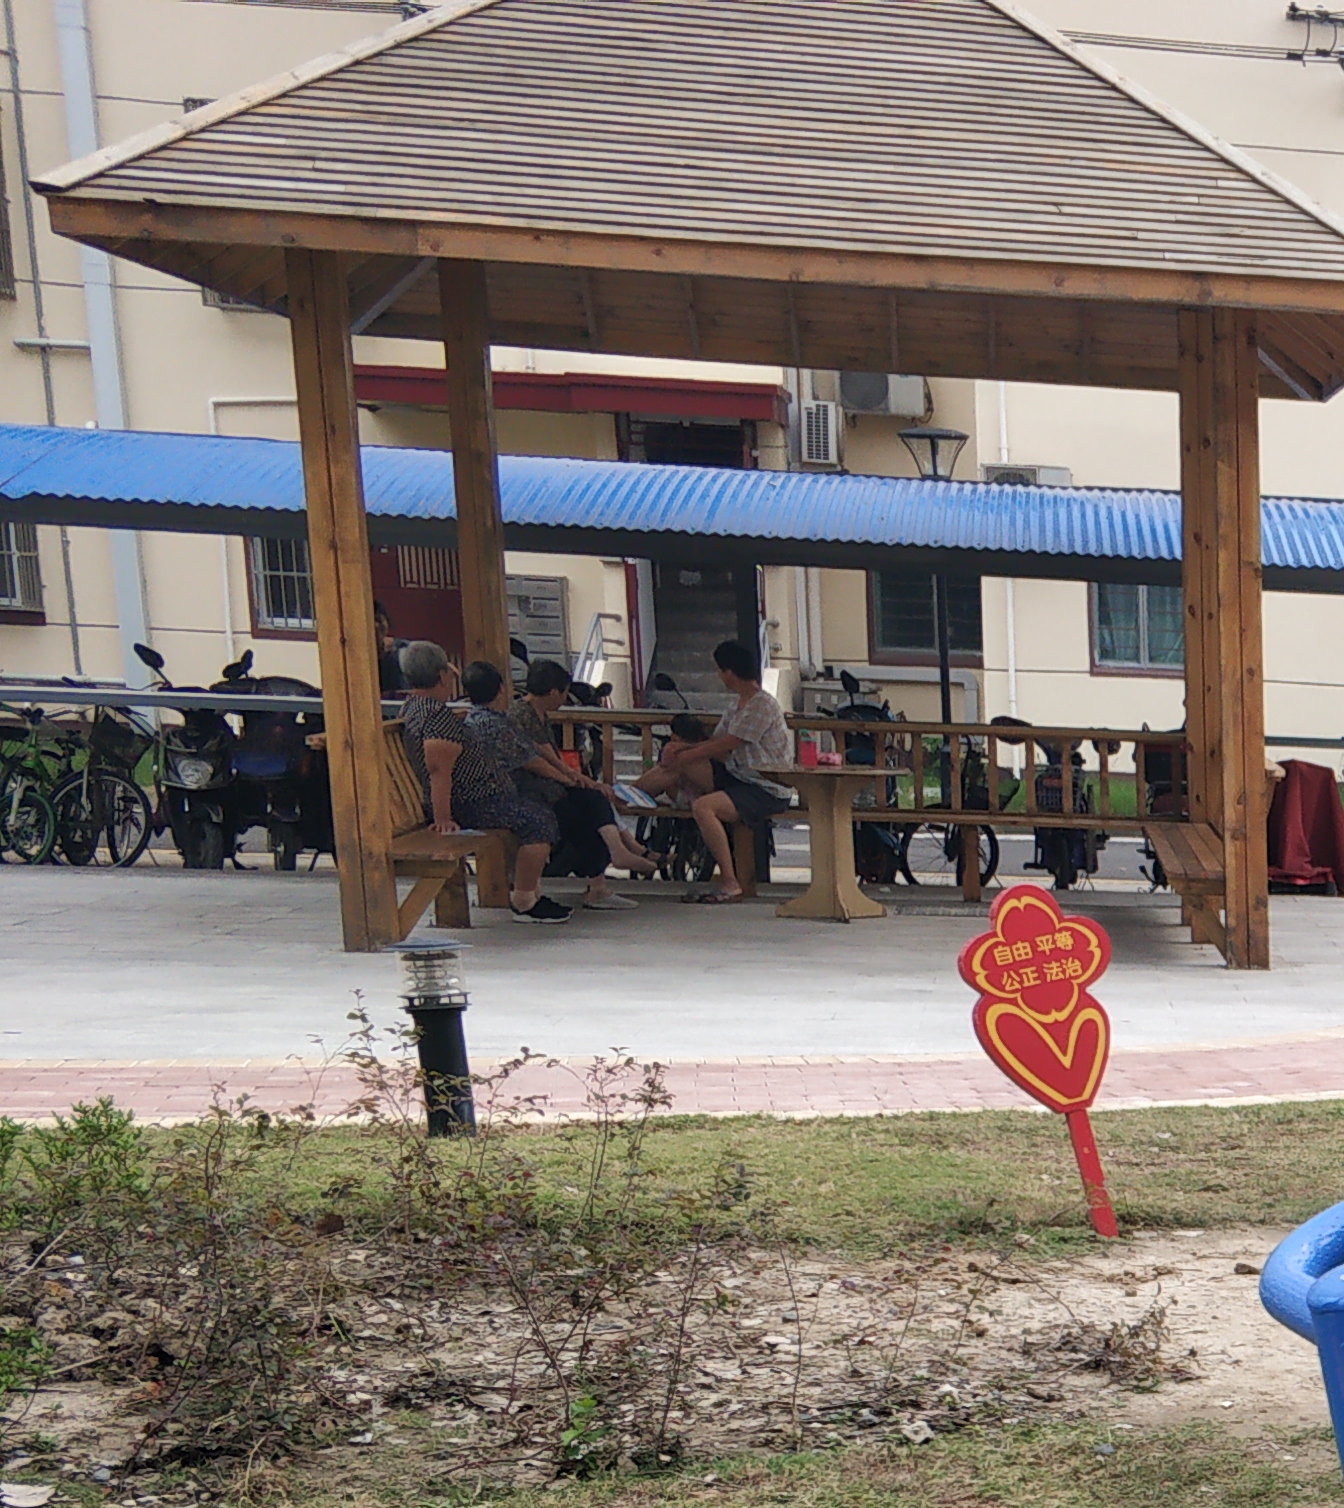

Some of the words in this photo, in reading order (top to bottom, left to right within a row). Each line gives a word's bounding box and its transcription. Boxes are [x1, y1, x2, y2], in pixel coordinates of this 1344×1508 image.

[993, 941, 1033, 966] 自由
[1035, 931, 1075, 955] 平等
[1001, 966, 1041, 991] 公正
[1043, 957, 1082, 982] 法治
